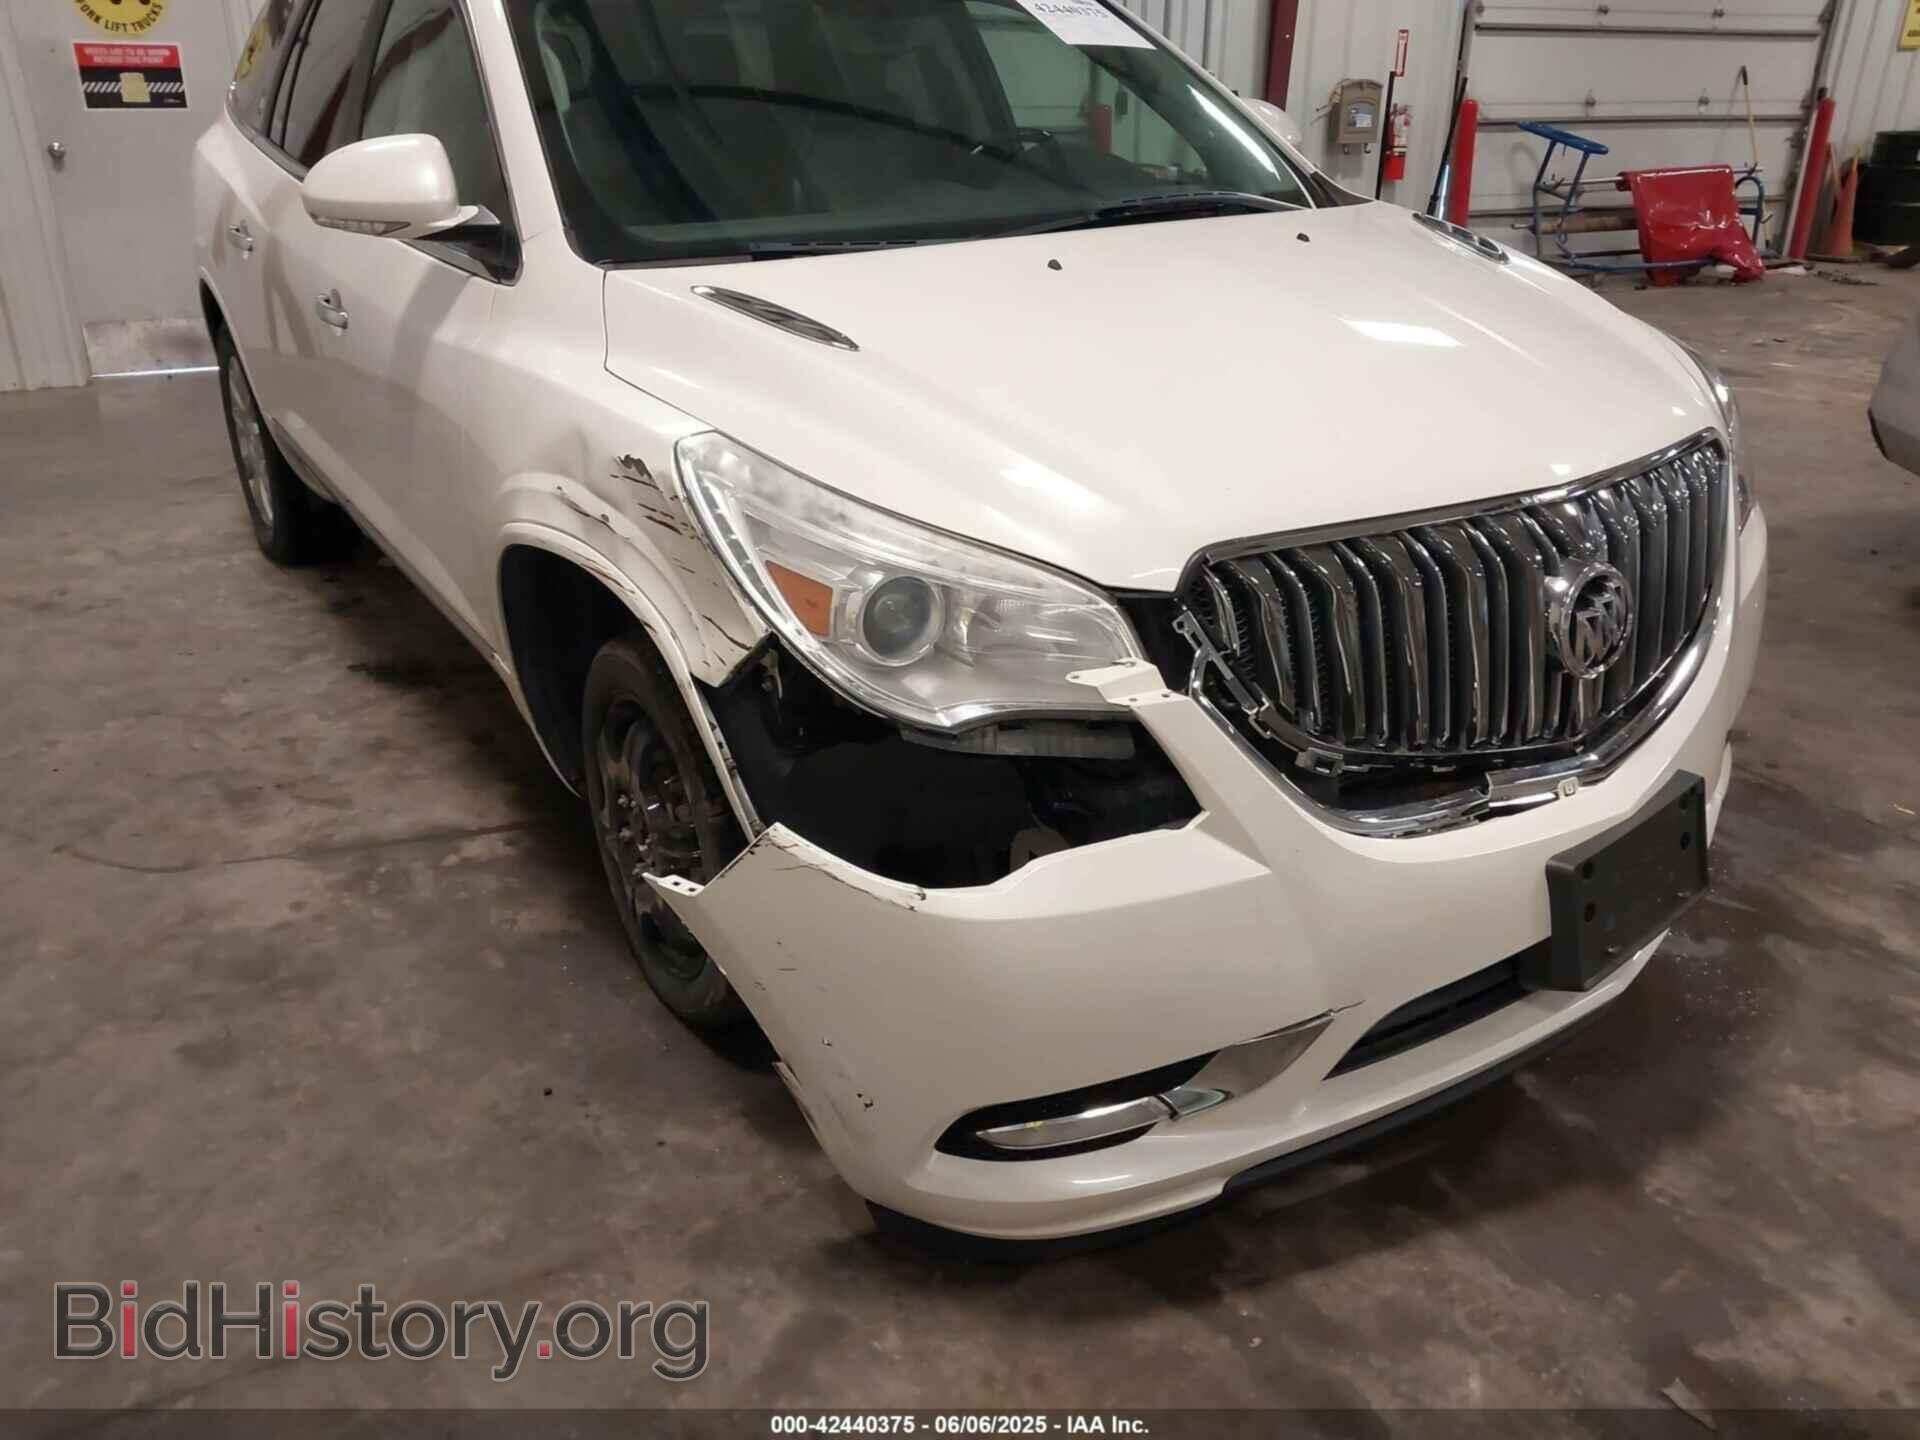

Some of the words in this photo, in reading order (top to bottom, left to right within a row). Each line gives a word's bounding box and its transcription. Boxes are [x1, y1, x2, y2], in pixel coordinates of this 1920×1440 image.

[75, 0, 102, 24] ORK
[104, 19, 128, 32] LIFT
[129, 2, 163, 32] TRUCKS
